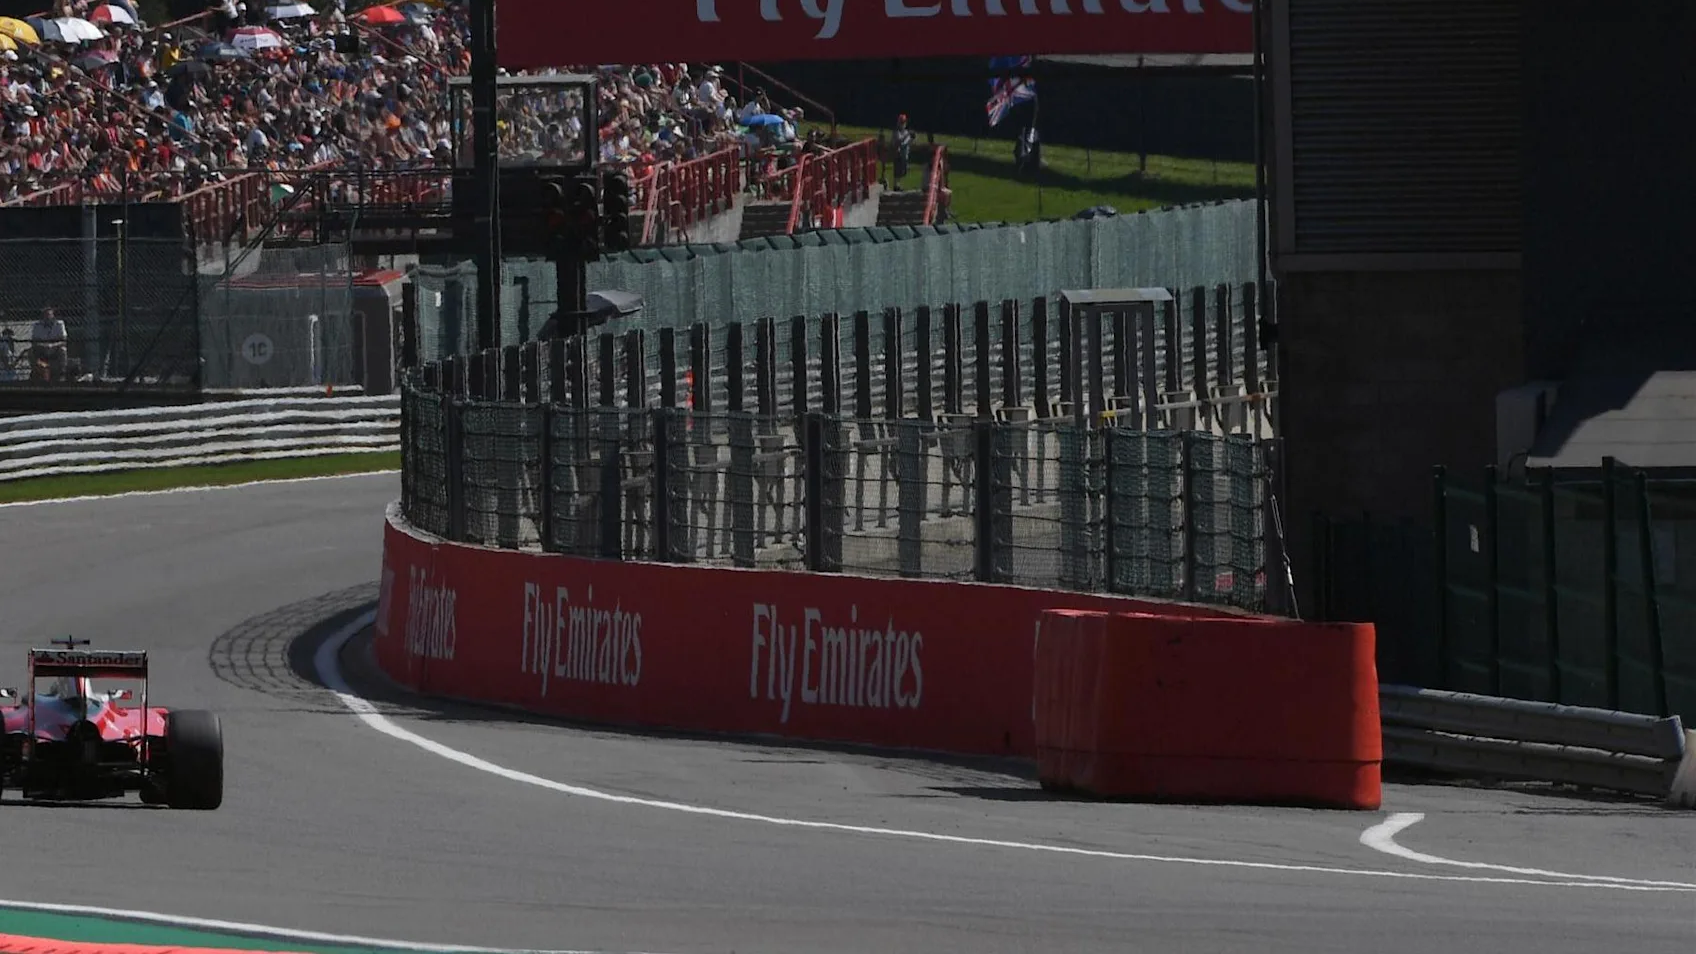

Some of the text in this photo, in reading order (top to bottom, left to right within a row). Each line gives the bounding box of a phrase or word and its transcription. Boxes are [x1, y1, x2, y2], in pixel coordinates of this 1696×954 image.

[56, 651, 142, 665] Santander
[521, 581, 553, 698] Fly
[555, 583, 642, 688] Emirates
[750, 603, 924, 724] Fly Emirates
